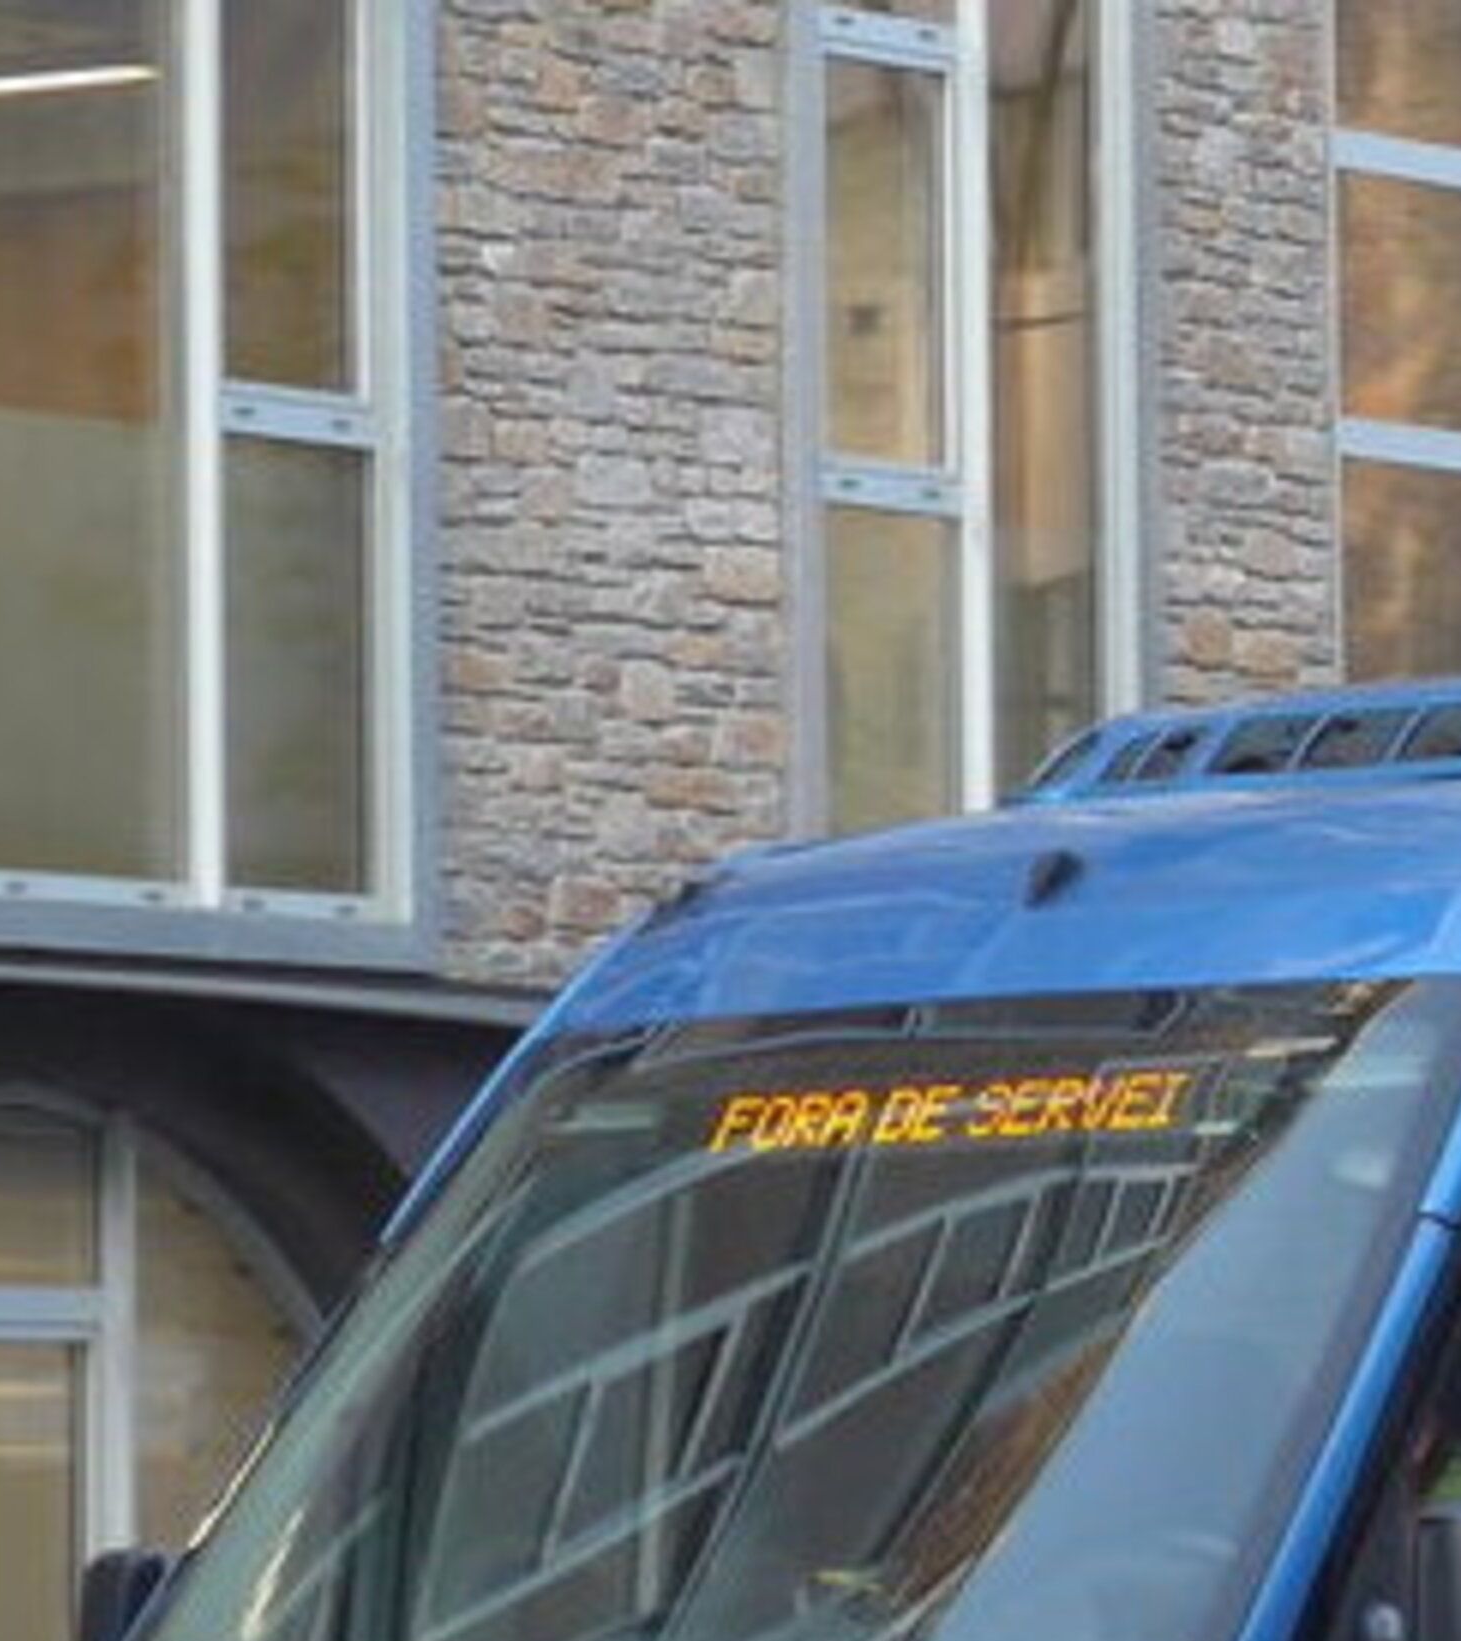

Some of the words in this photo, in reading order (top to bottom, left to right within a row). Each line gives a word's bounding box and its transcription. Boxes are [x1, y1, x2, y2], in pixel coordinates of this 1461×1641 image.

[709, 1093, 870, 1152] FORA
[873, 1084, 961, 1144] DE
[968, 1072, 1190, 1137] SERVEI
